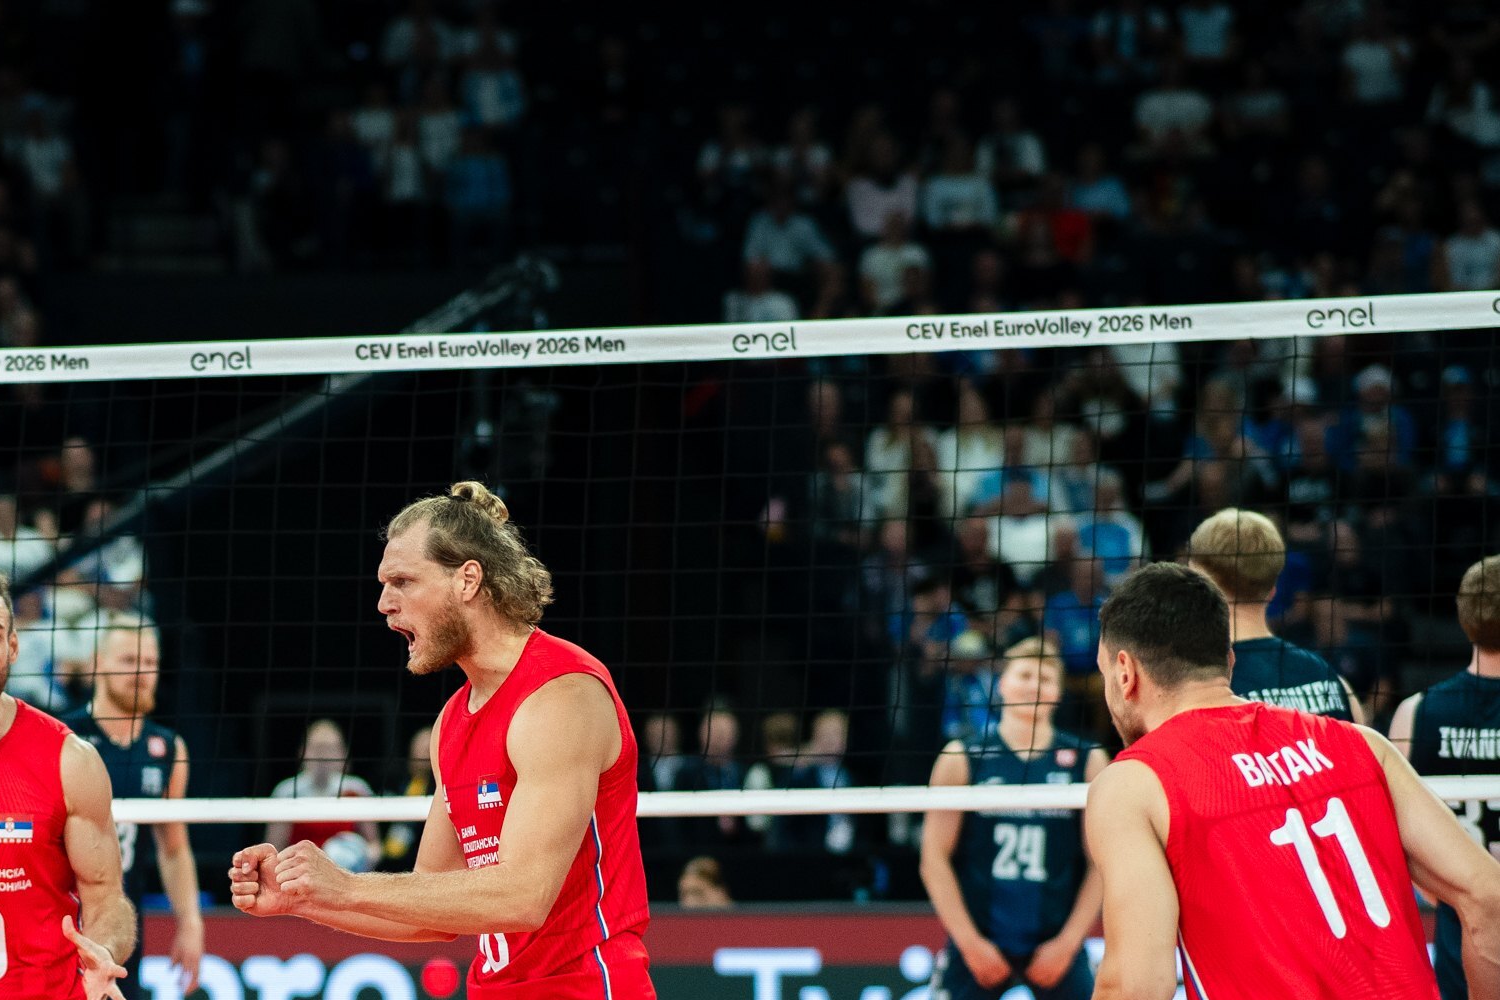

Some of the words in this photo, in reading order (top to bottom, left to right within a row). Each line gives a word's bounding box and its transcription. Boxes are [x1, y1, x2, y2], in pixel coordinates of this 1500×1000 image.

[906, 322, 945, 340] CEV
[950, 320, 988, 338] Enel
[994, 316, 1092, 338] EuroVolley
[1098, 314, 1144, 333] 2026
[1150, 313, 1192, 330] Men
[1306, 302, 1375, 329] enel
[355, 343, 392, 360] CEV
[397, 341, 433, 359] Enel
[439, 338, 531, 360] EuroVolley
[536, 338, 580, 355] 2026
[585, 336, 625, 353] Men
[732, 327, 797, 353] enel
[5, 354, 46, 371] 2026
[51, 354, 89, 370] Men
[190, 346, 252, 371] enel
[1438, 726, 1500, 760] IVAN
[1231, 738, 1334, 788] BATAK
[992, 823, 1048, 882] 24
[1269, 797, 1391, 939] 11
